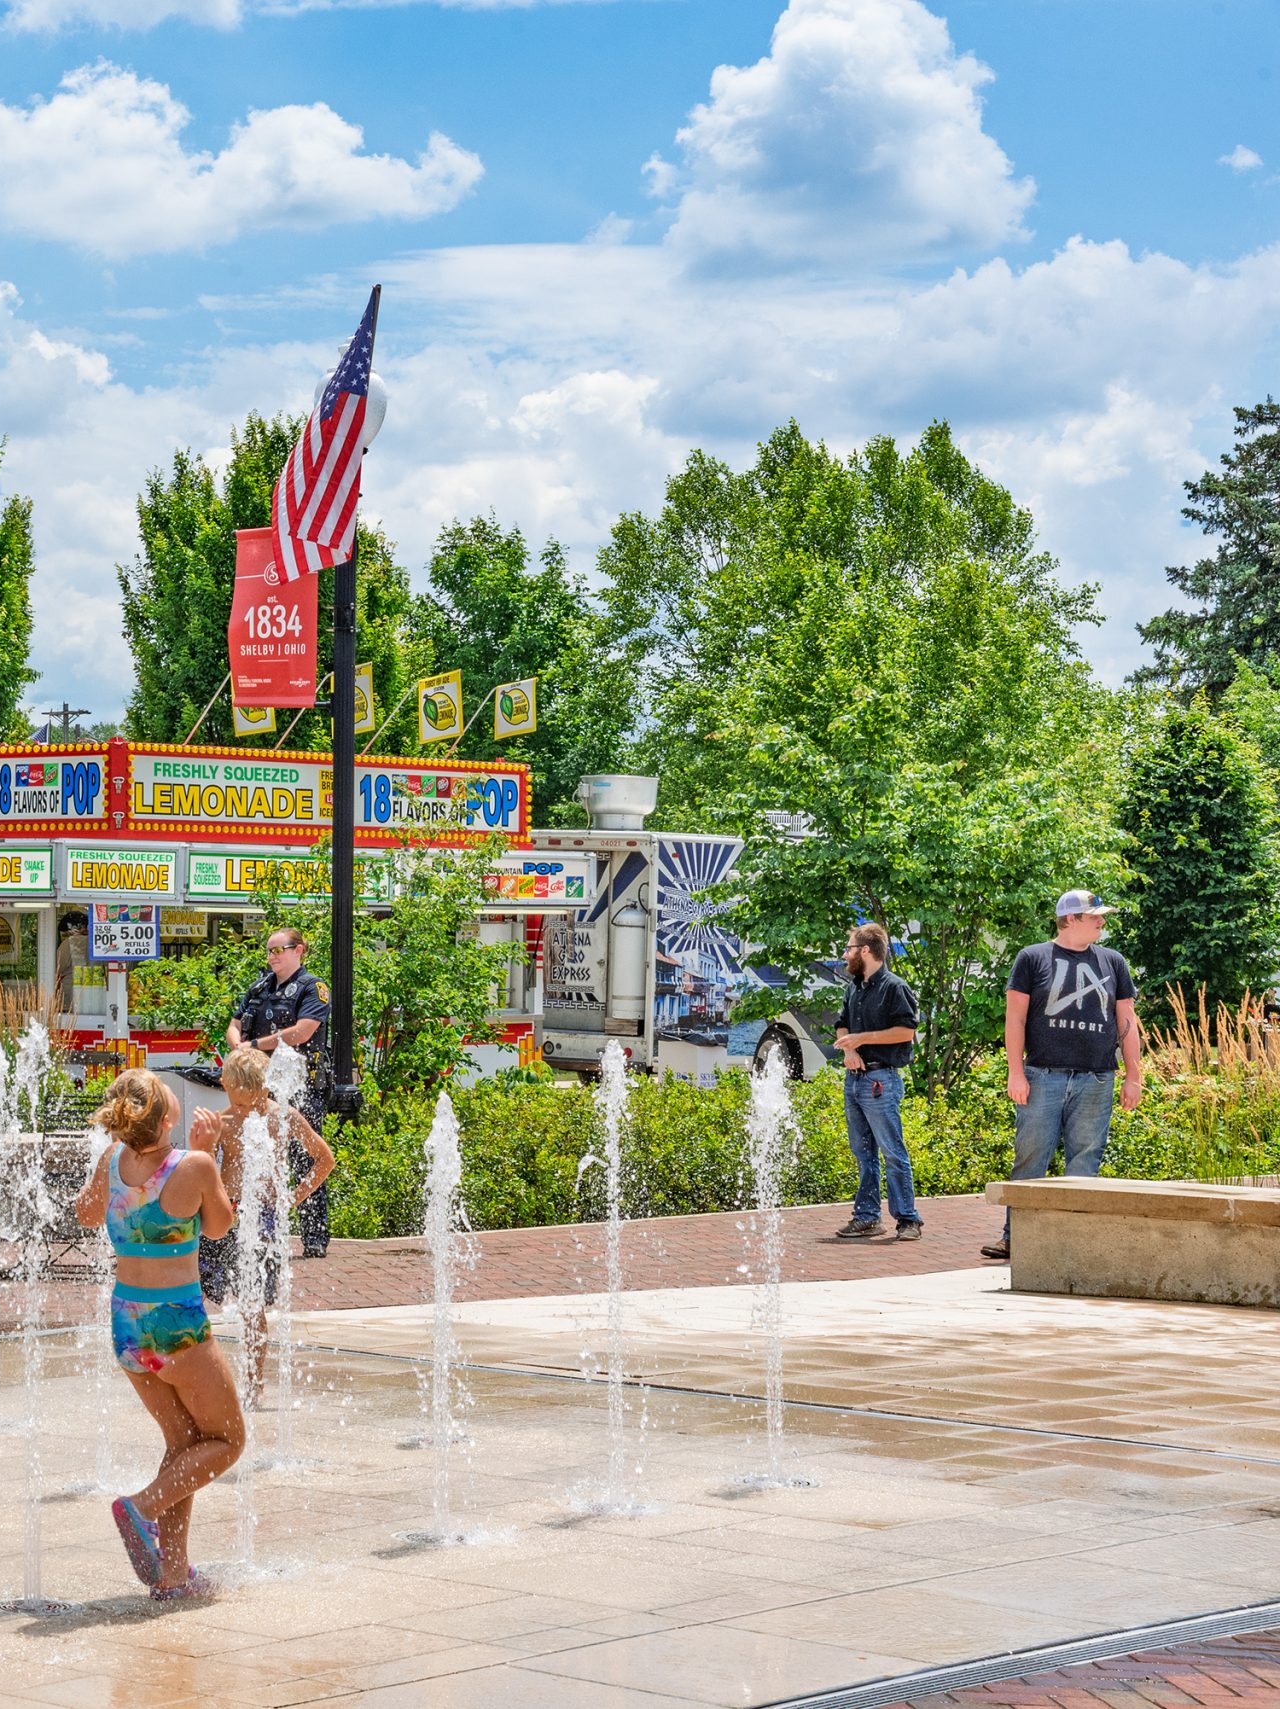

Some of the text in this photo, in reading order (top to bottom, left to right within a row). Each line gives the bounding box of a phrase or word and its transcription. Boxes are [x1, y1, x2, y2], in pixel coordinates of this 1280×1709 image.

[244, 604, 302, 639] 1834
[240, 643, 306, 656] SHELBY OHIO
[153, 762, 300, 783] FRESHLY SQUEEZED
[61, 762, 101, 815] POP
[14, 789, 60, 814] FLAVORS OF
[134, 782, 314, 820] LEMONADE
[360, 774, 391, 823] 18
[466, 778, 518, 827] POP
[393, 800, 446, 823] FLAVORS
[70, 851, 173, 862] FRESHLY SQUEEZED
[24, 860, 45, 871] SHAKE
[195, 862, 218, 874] FRESHLY
[523, 862, 564, 876] POP
[30, 873, 39, 883] UP
[72, 862, 169, 891] LEMONADE
[193, 874, 222, 886] SQUEEZED
[225, 859, 364, 894] LEMONAE
[162, 911, 206, 925] EMONADE
[95, 934, 117, 946] POP
[120, 926, 154, 940] 5.00
[552, 966, 591, 982] EXPRESS
[1044, 958, 1111, 1022] LA
[1049, 1018, 1105, 1033] KNIGHT
